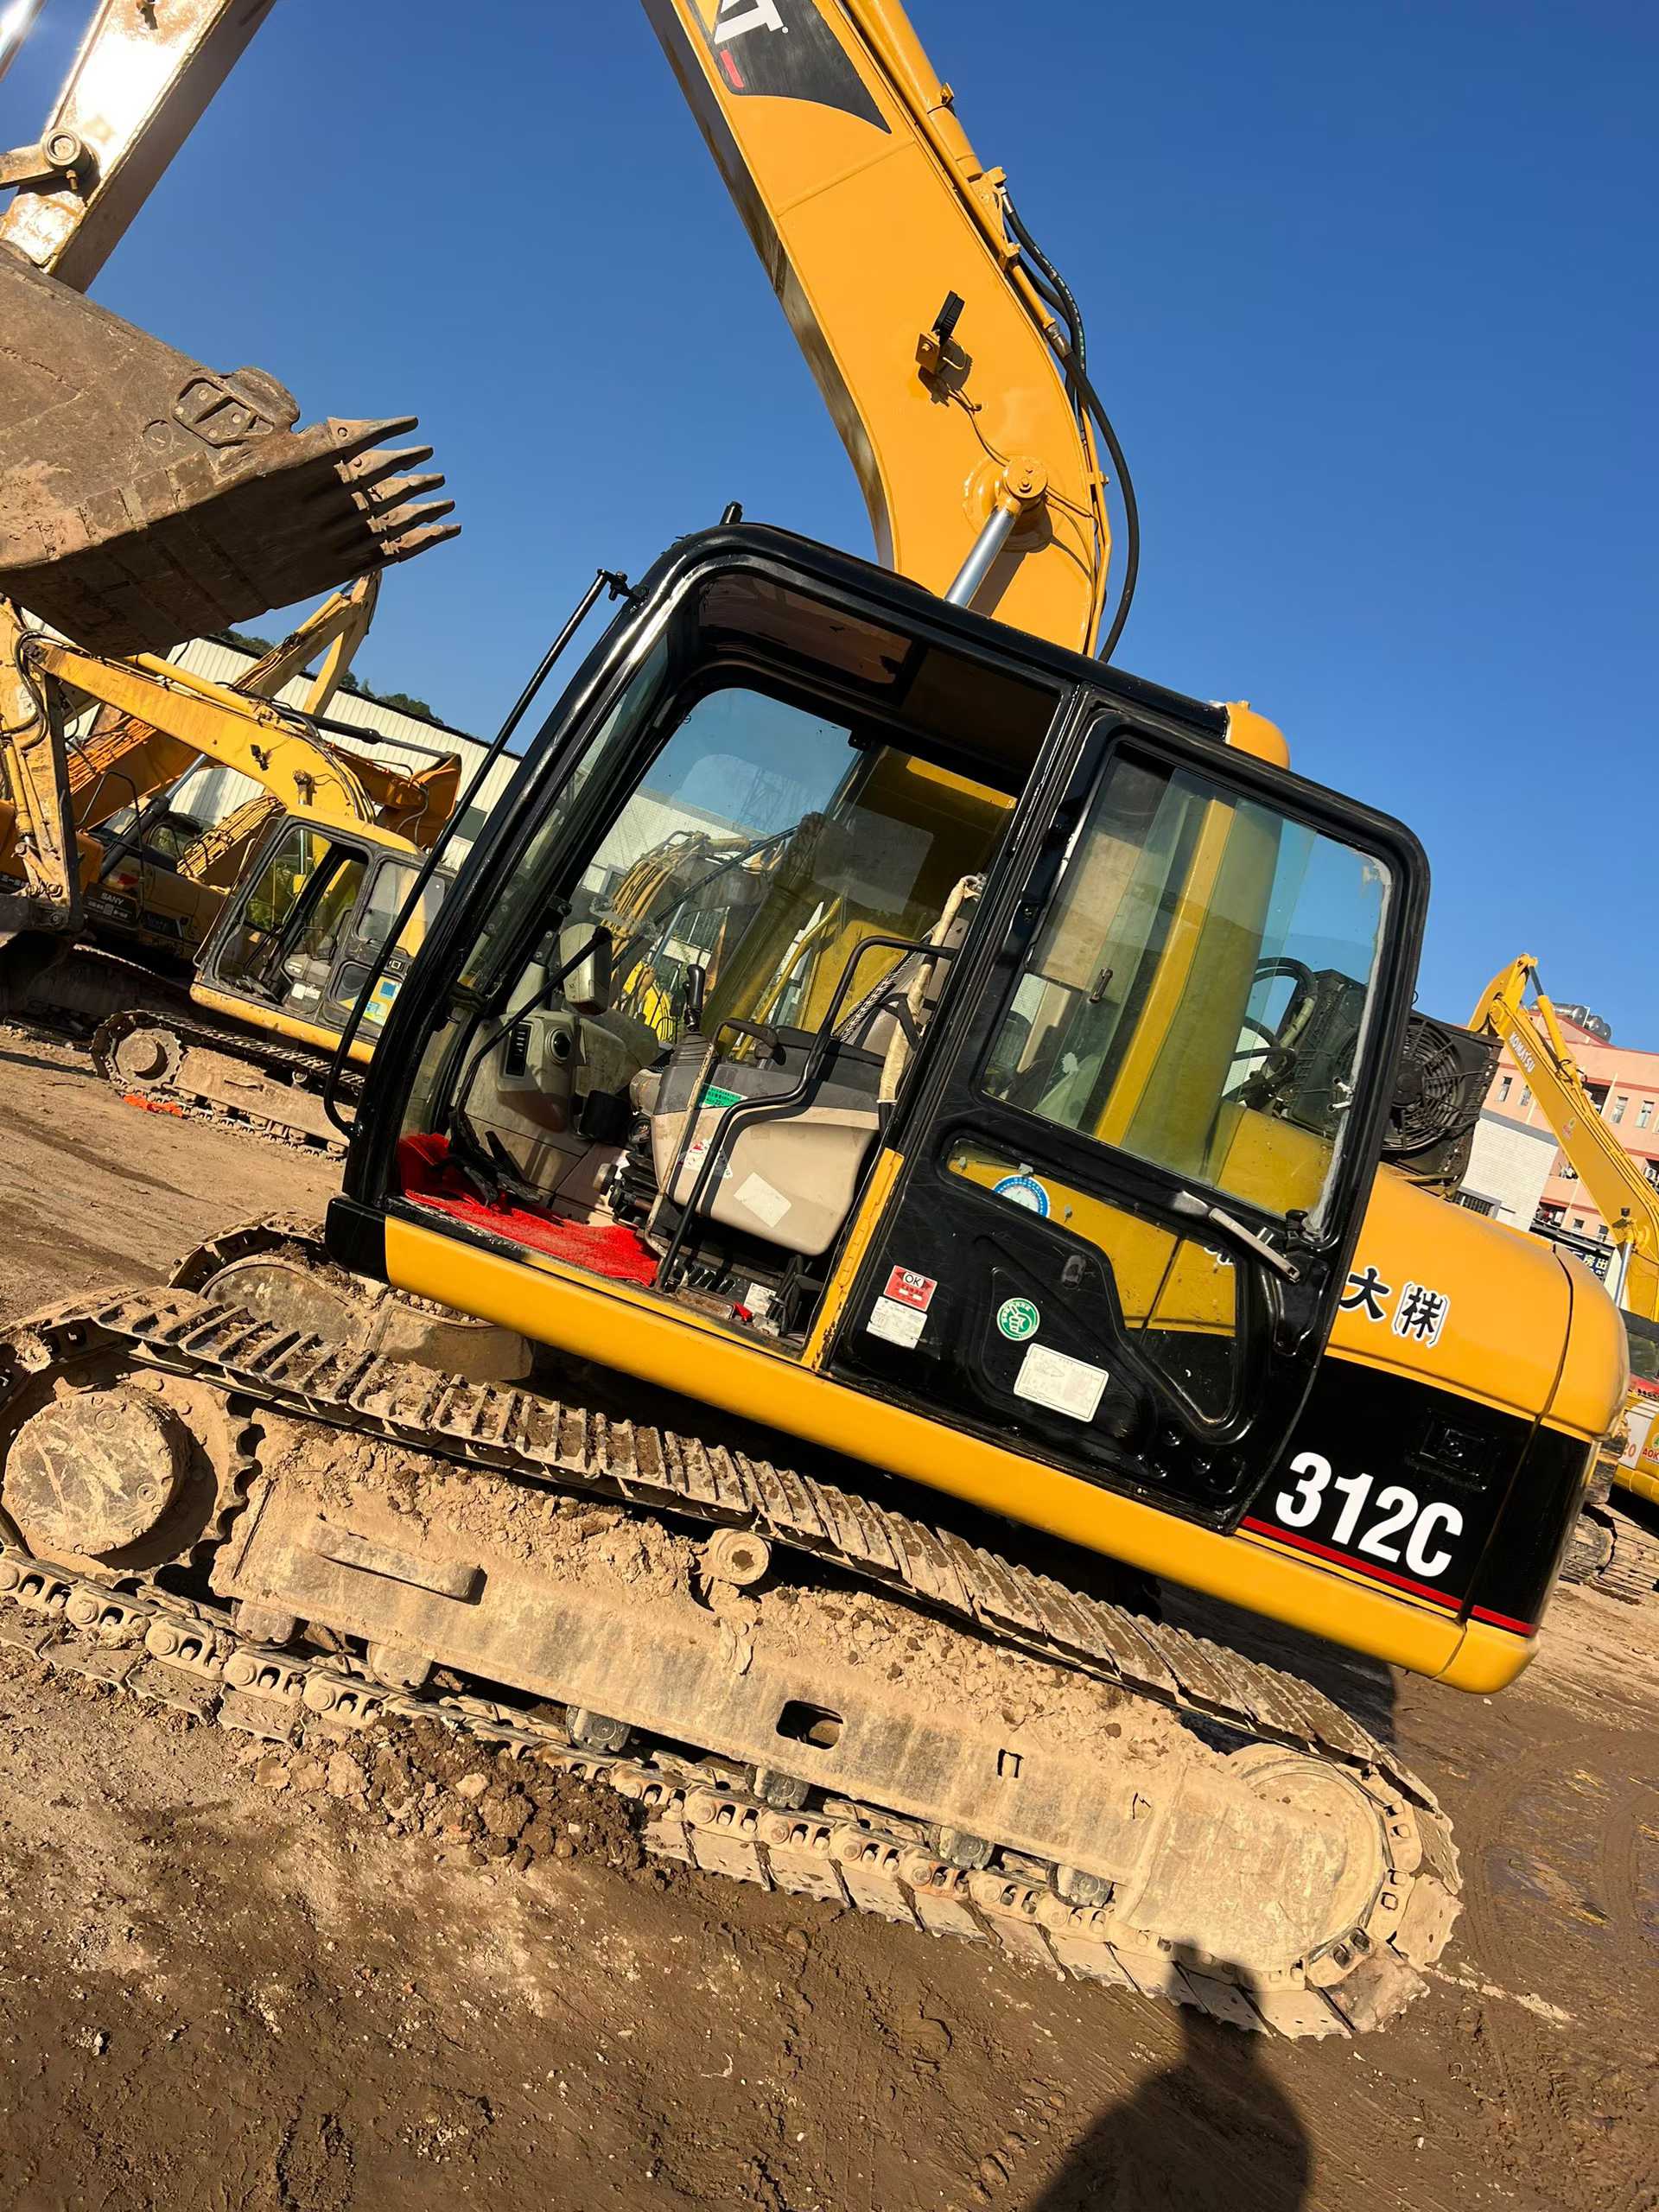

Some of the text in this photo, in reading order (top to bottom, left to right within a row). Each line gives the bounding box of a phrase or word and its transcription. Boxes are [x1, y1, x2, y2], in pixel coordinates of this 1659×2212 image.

[100, 892, 124, 906] SANY
[1509, 1031, 1535, 1073] KOMATSU
[905, 1274, 922, 1287] OK
[1275, 1452, 1464, 1577] 312C
